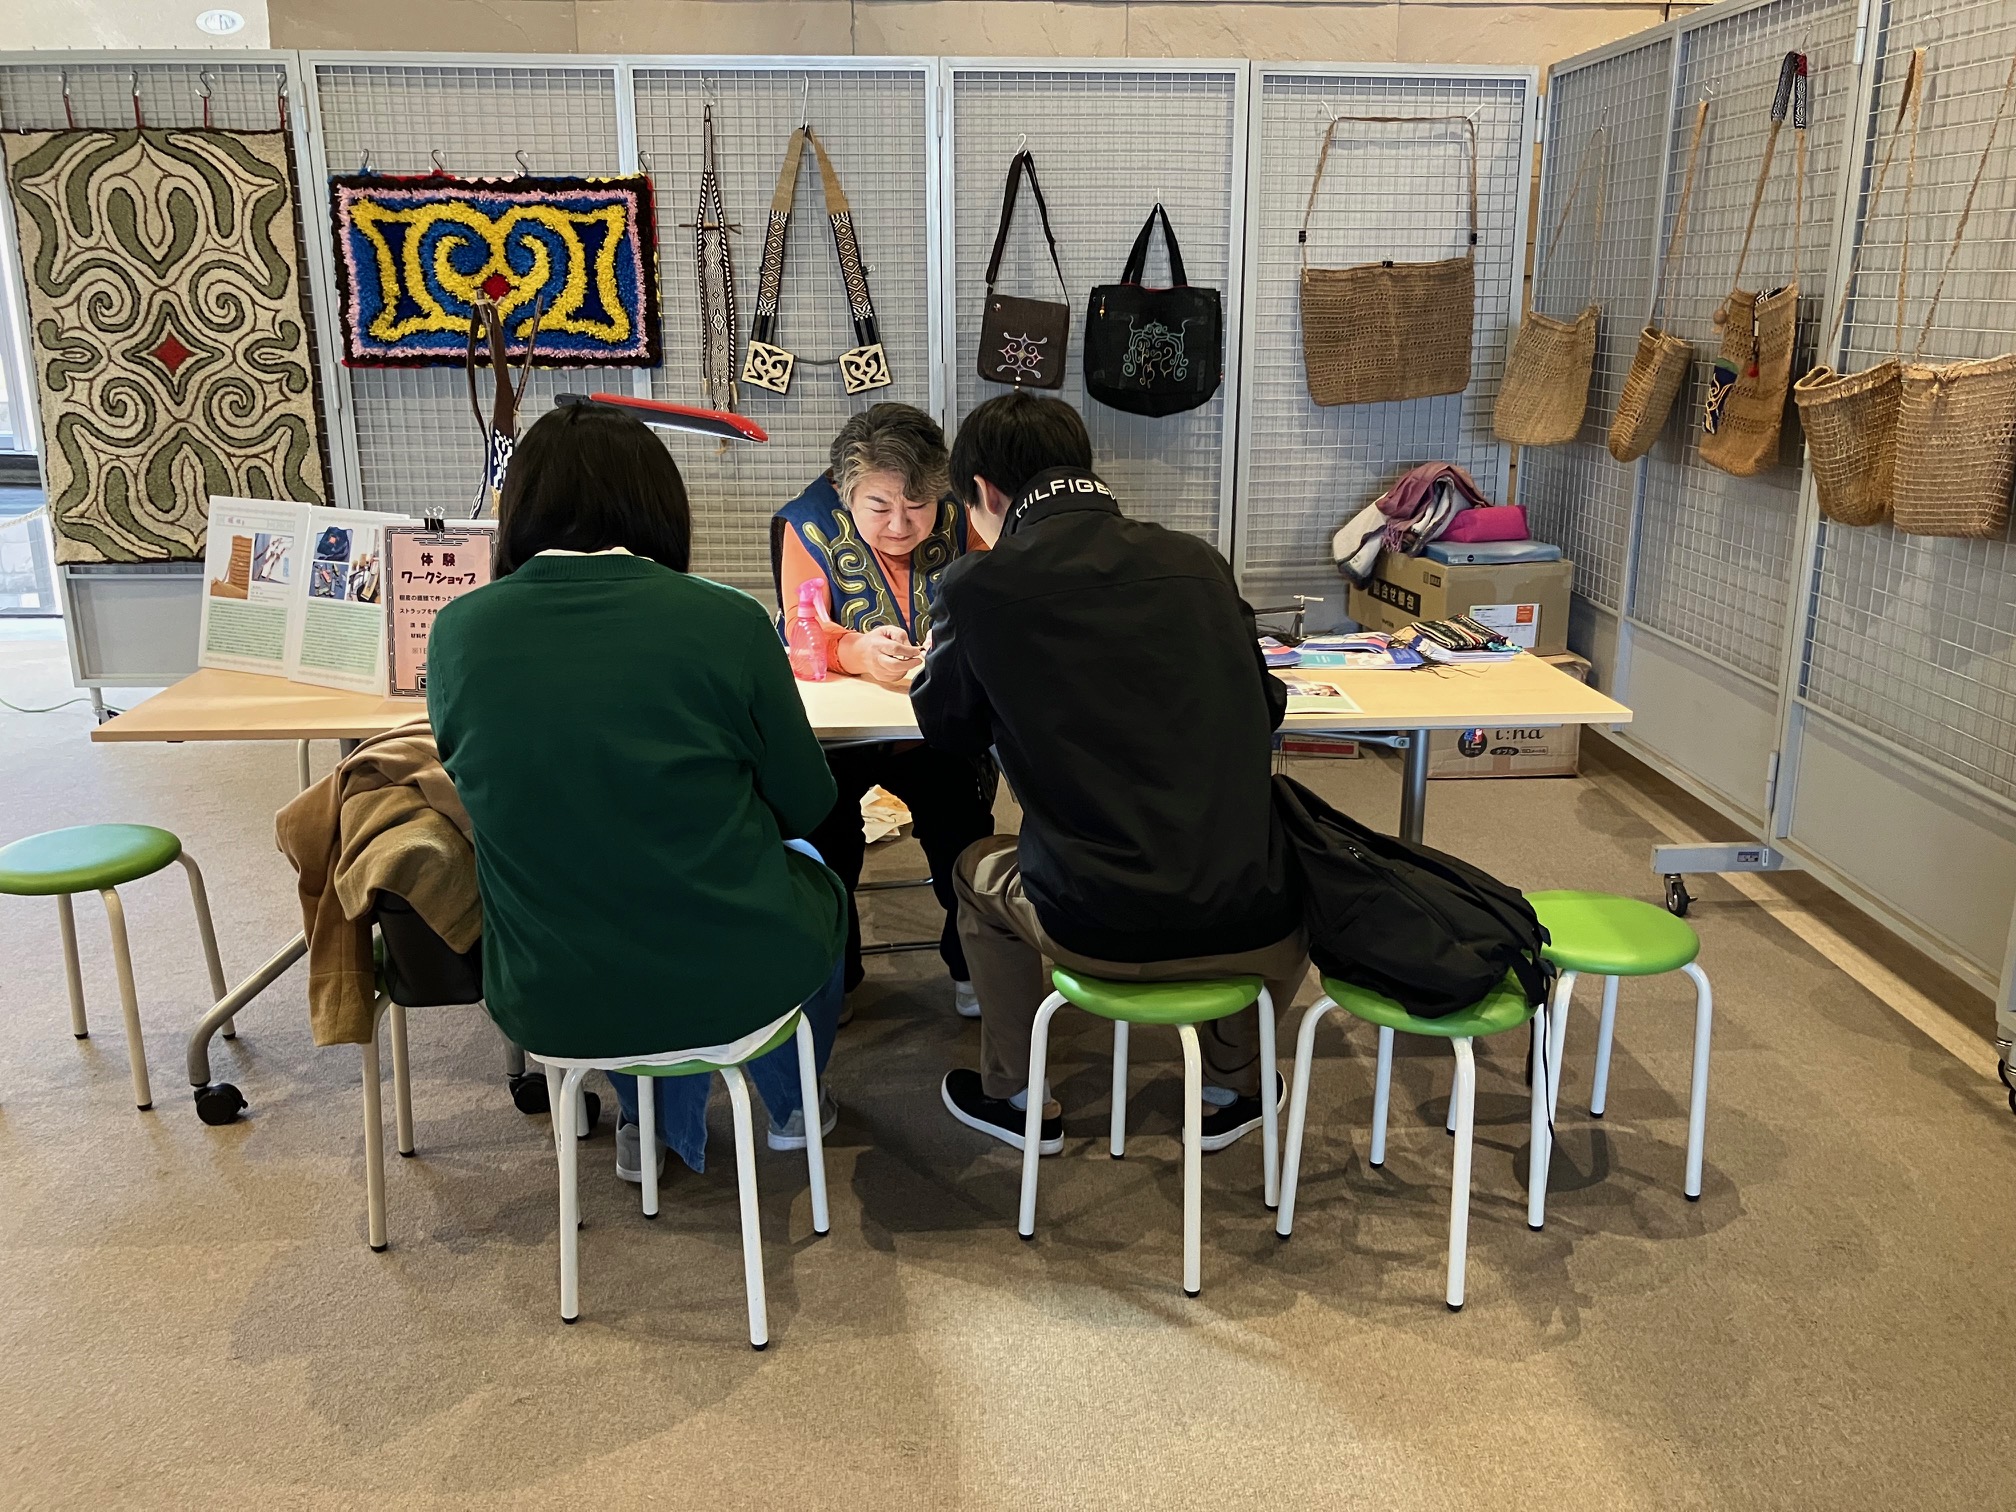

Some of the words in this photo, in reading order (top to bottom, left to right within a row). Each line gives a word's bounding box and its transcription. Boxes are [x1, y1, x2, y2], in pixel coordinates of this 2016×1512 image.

[421, 552, 456, 567] 体験
[401, 571, 476, 585] ワークショップ
